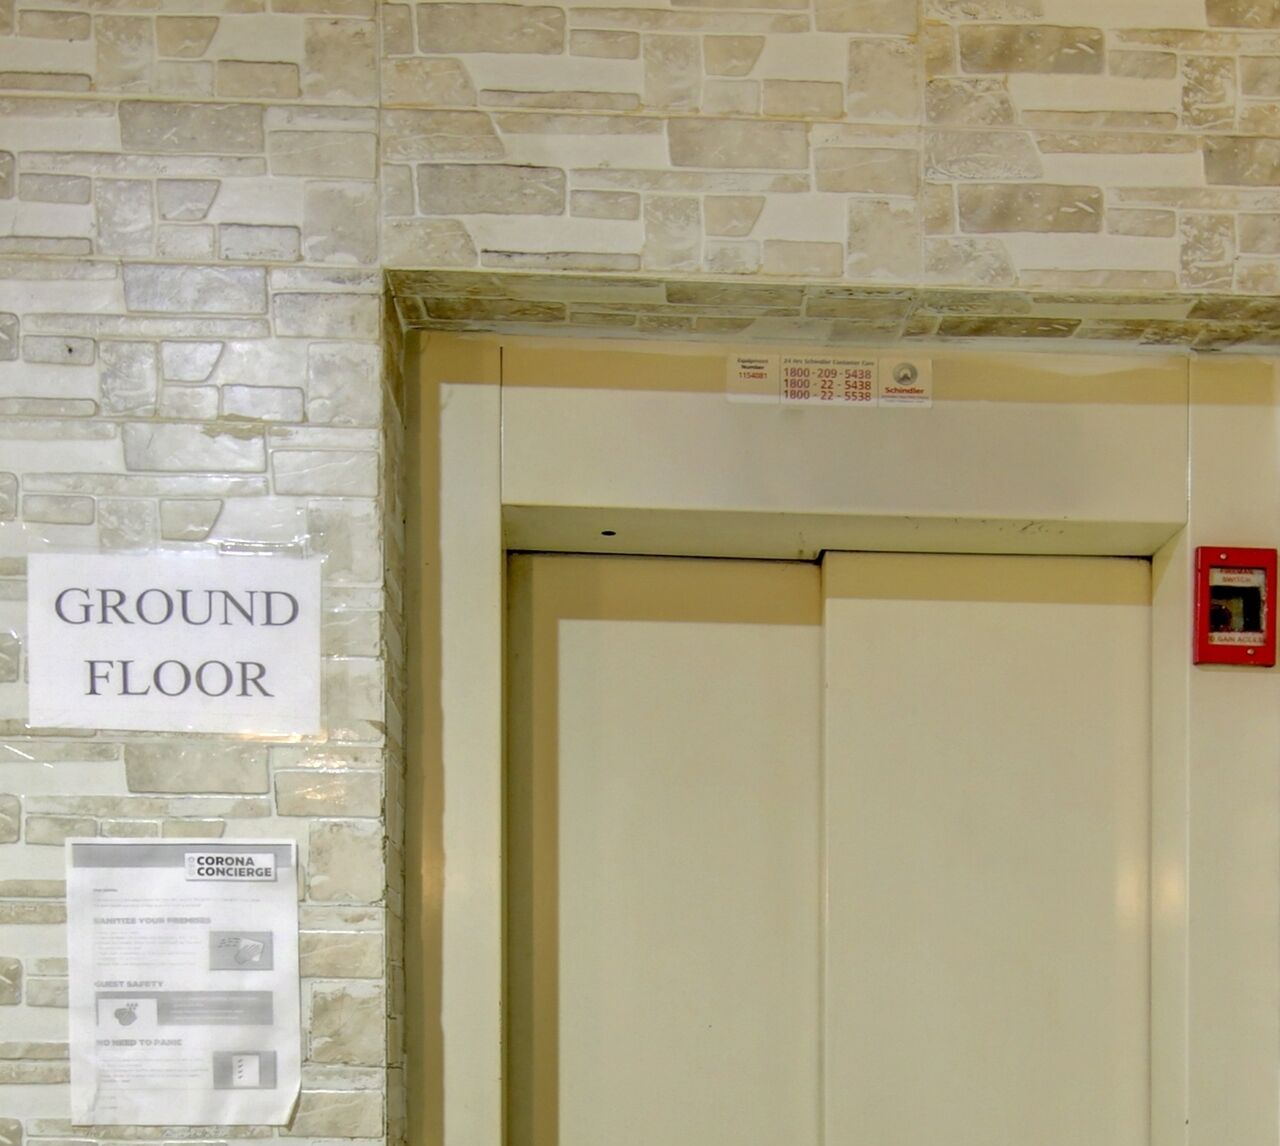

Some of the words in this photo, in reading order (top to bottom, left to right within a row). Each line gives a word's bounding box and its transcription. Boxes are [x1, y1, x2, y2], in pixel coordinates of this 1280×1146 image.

[783, 367, 810, 378] 1800
[816, 368, 838, 379] 209
[844, 369, 872, 380] 5438
[783, 379, 810, 389] 1800
[820, 379, 834, 390] 22
[844, 380, 872, 391] 5438
[884, 386, 925, 395] Schindler
[783, 390, 810, 400] 1800
[820, 390, 834, 401] 22
[844, 391, 872, 402] 5538
[54, 587, 299, 627] GROUND
[84, 659, 274, 697] FLOOR
[196, 856, 255, 867] CORONA
[196, 866, 272, 878] CONCIERGE
[138, 1039, 153, 1047] TO
